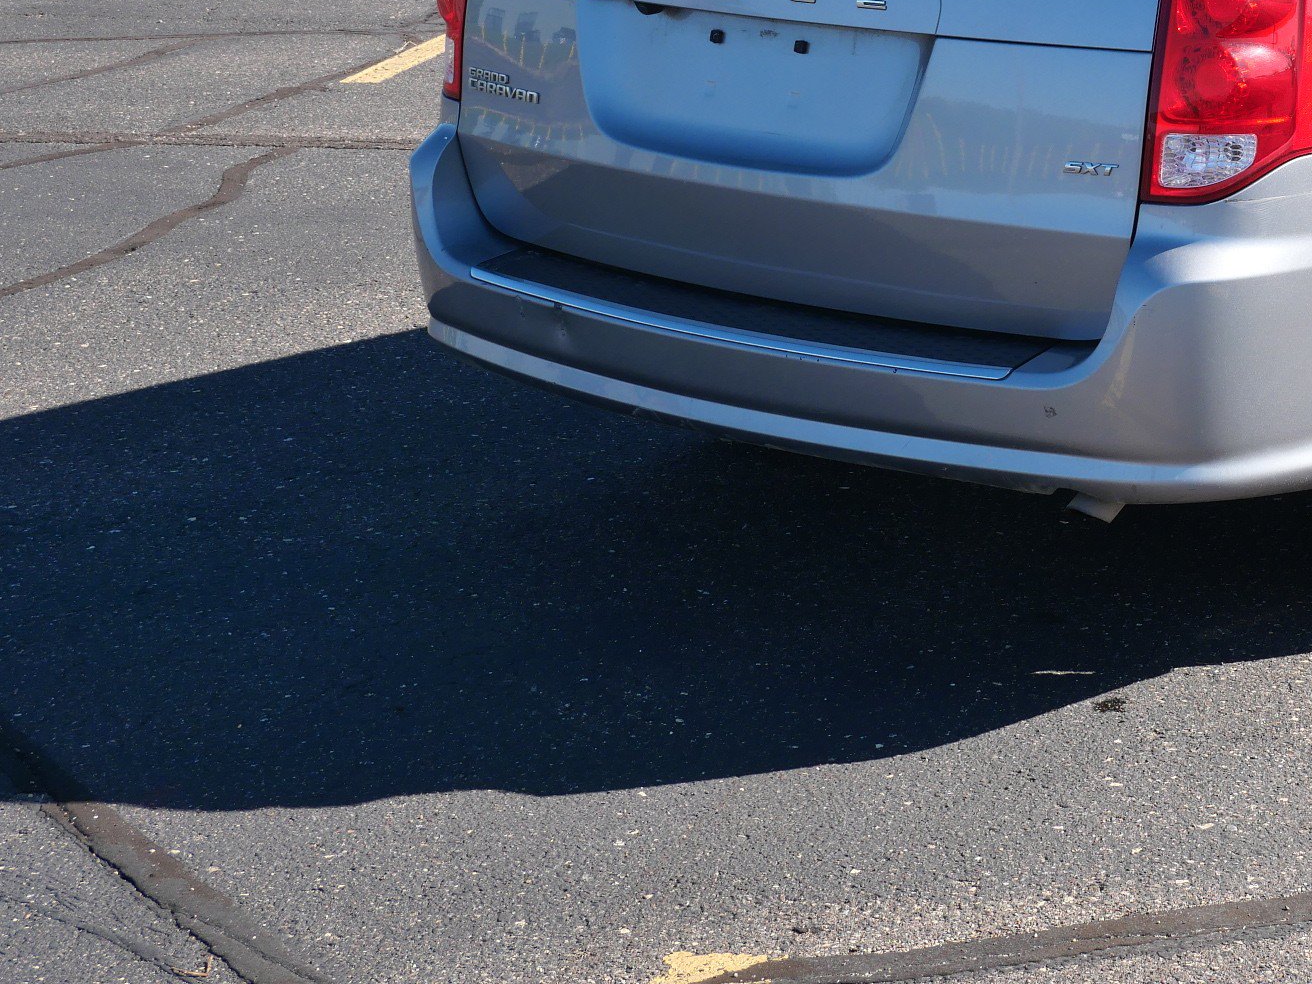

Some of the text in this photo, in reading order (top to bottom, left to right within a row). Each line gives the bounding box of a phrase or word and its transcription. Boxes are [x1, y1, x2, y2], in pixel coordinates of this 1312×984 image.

[469, 67, 510, 84] GRAND
[469, 78, 540, 104] CARAVAN
[1063, 160, 1119, 176] SXT
